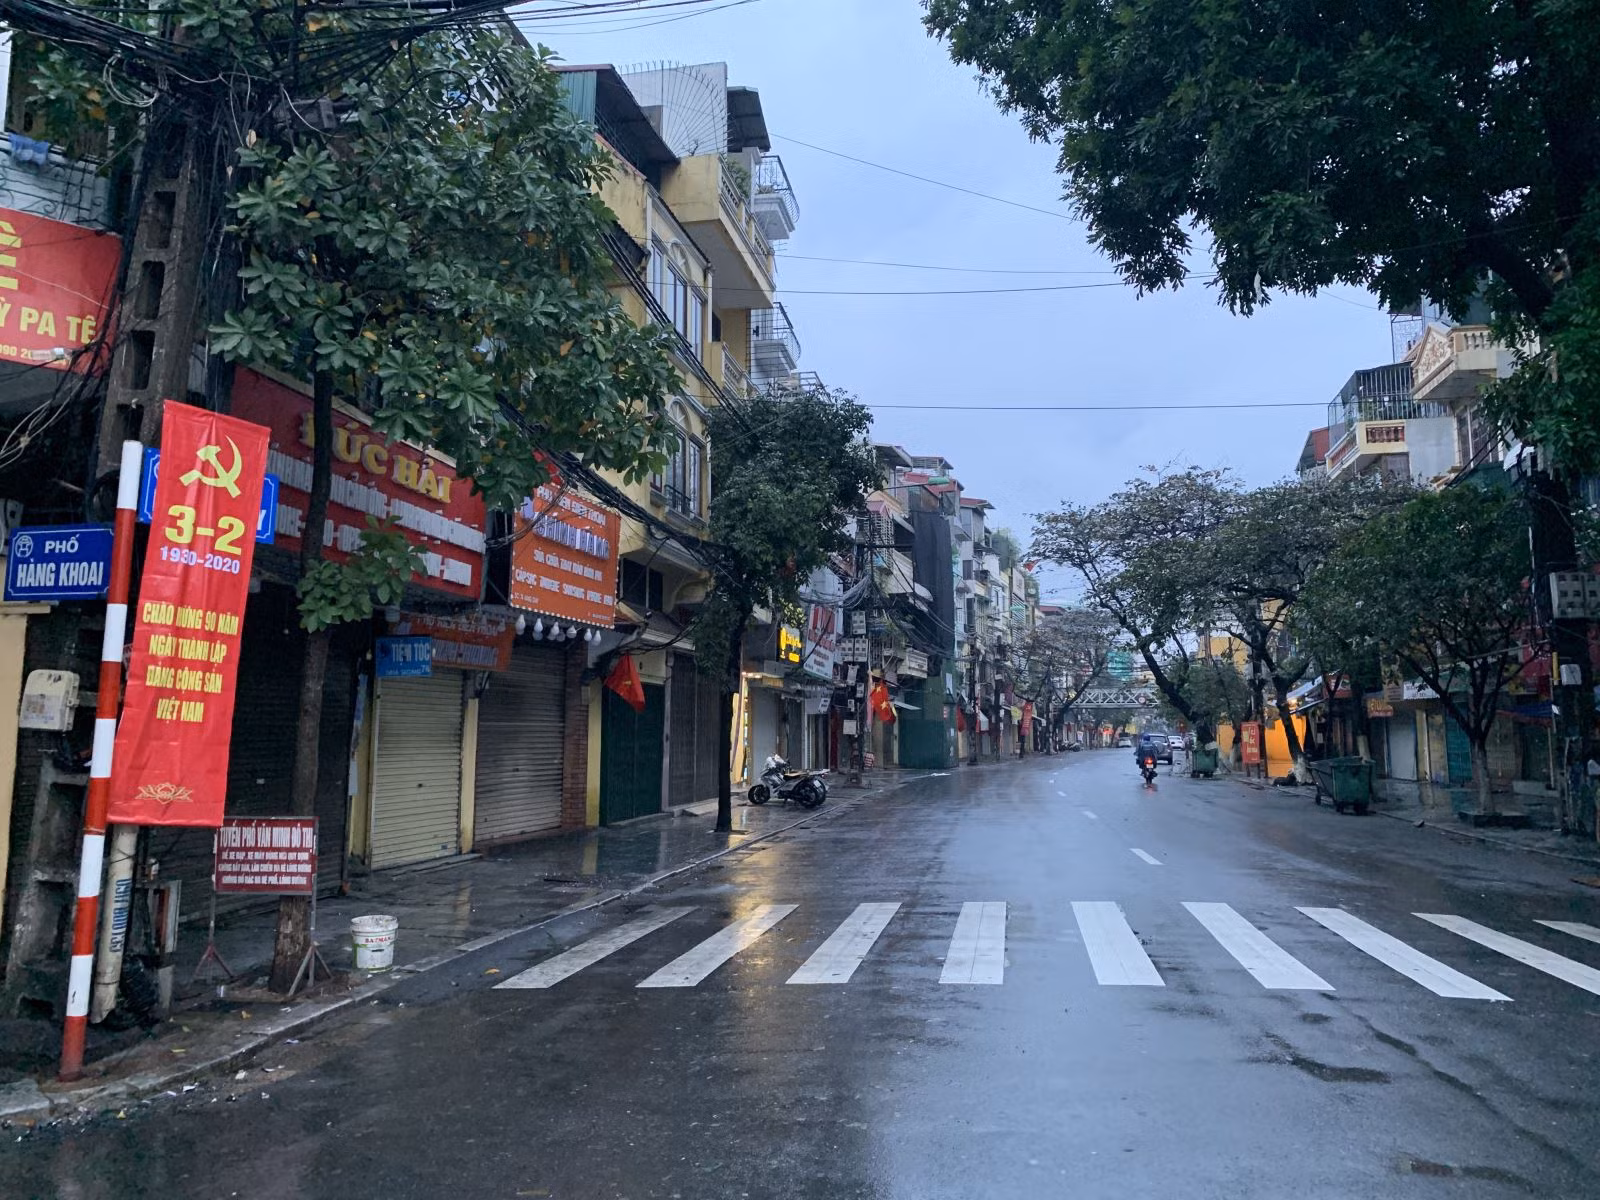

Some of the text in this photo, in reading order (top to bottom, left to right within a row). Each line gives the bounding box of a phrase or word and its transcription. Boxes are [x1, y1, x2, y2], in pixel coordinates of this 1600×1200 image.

[20, 307, 56, 338] PA
[66, 315, 97, 344] TÊ
[391, 457, 452, 504] HẢI
[44, 534, 80, 554] PHỐ
[164, 504, 245, 556] 3-2
[17, 558, 104, 588] HÀNG KHOAI
[160, 545, 240, 574] 1930-2020
[143, 601, 175, 624] CHÀO
[204, 611, 216, 632] 90
[217, 612, 239, 636] NĂM
[149, 633, 227, 667] NGÀY THÀNH LẬP
[145, 661, 223, 694] ĐẢNG CỘNG SẢN
[156, 695, 205, 723] VIỆT NAM
